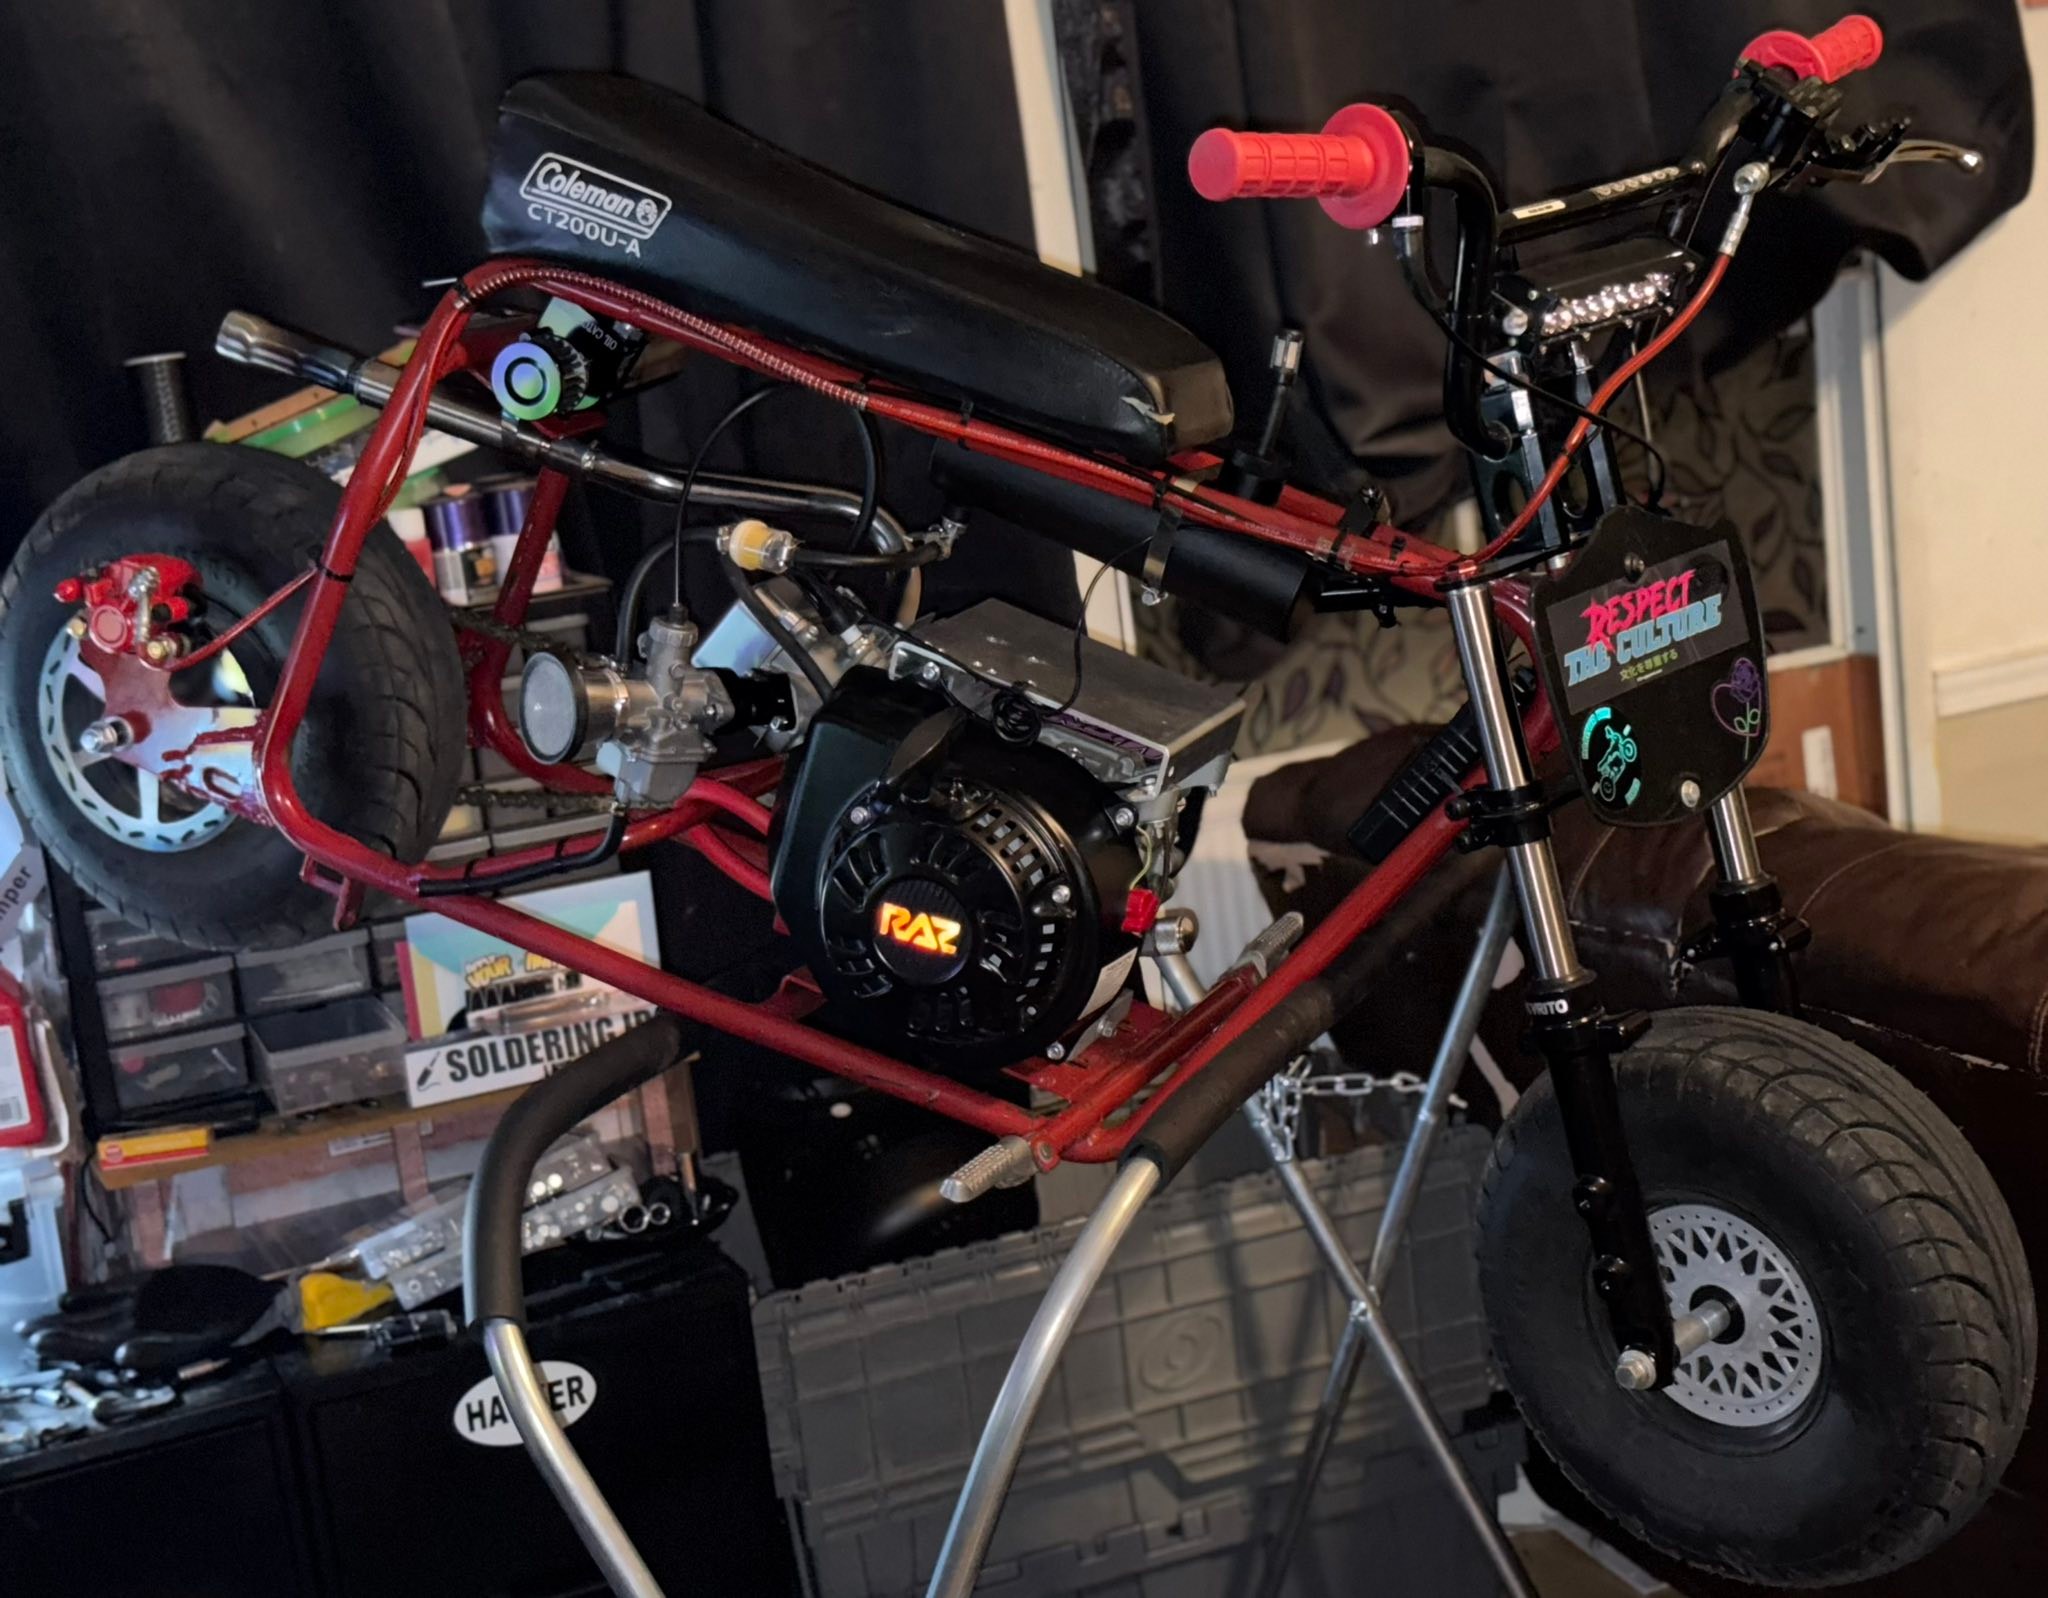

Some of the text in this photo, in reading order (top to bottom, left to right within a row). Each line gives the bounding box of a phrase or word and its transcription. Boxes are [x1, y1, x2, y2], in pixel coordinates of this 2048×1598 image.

[537, 162, 635, 218] Coleman
[527, 203, 640, 258] CT200U-A
[1564, 593, 1722, 687] THE CULTURE
[1580, 569, 1696, 654] RESPECT
[880, 902, 961, 954] RAZ
[446, 1017, 615, 1082] SOLDERING
[466, 1375, 587, 1432] HAER
